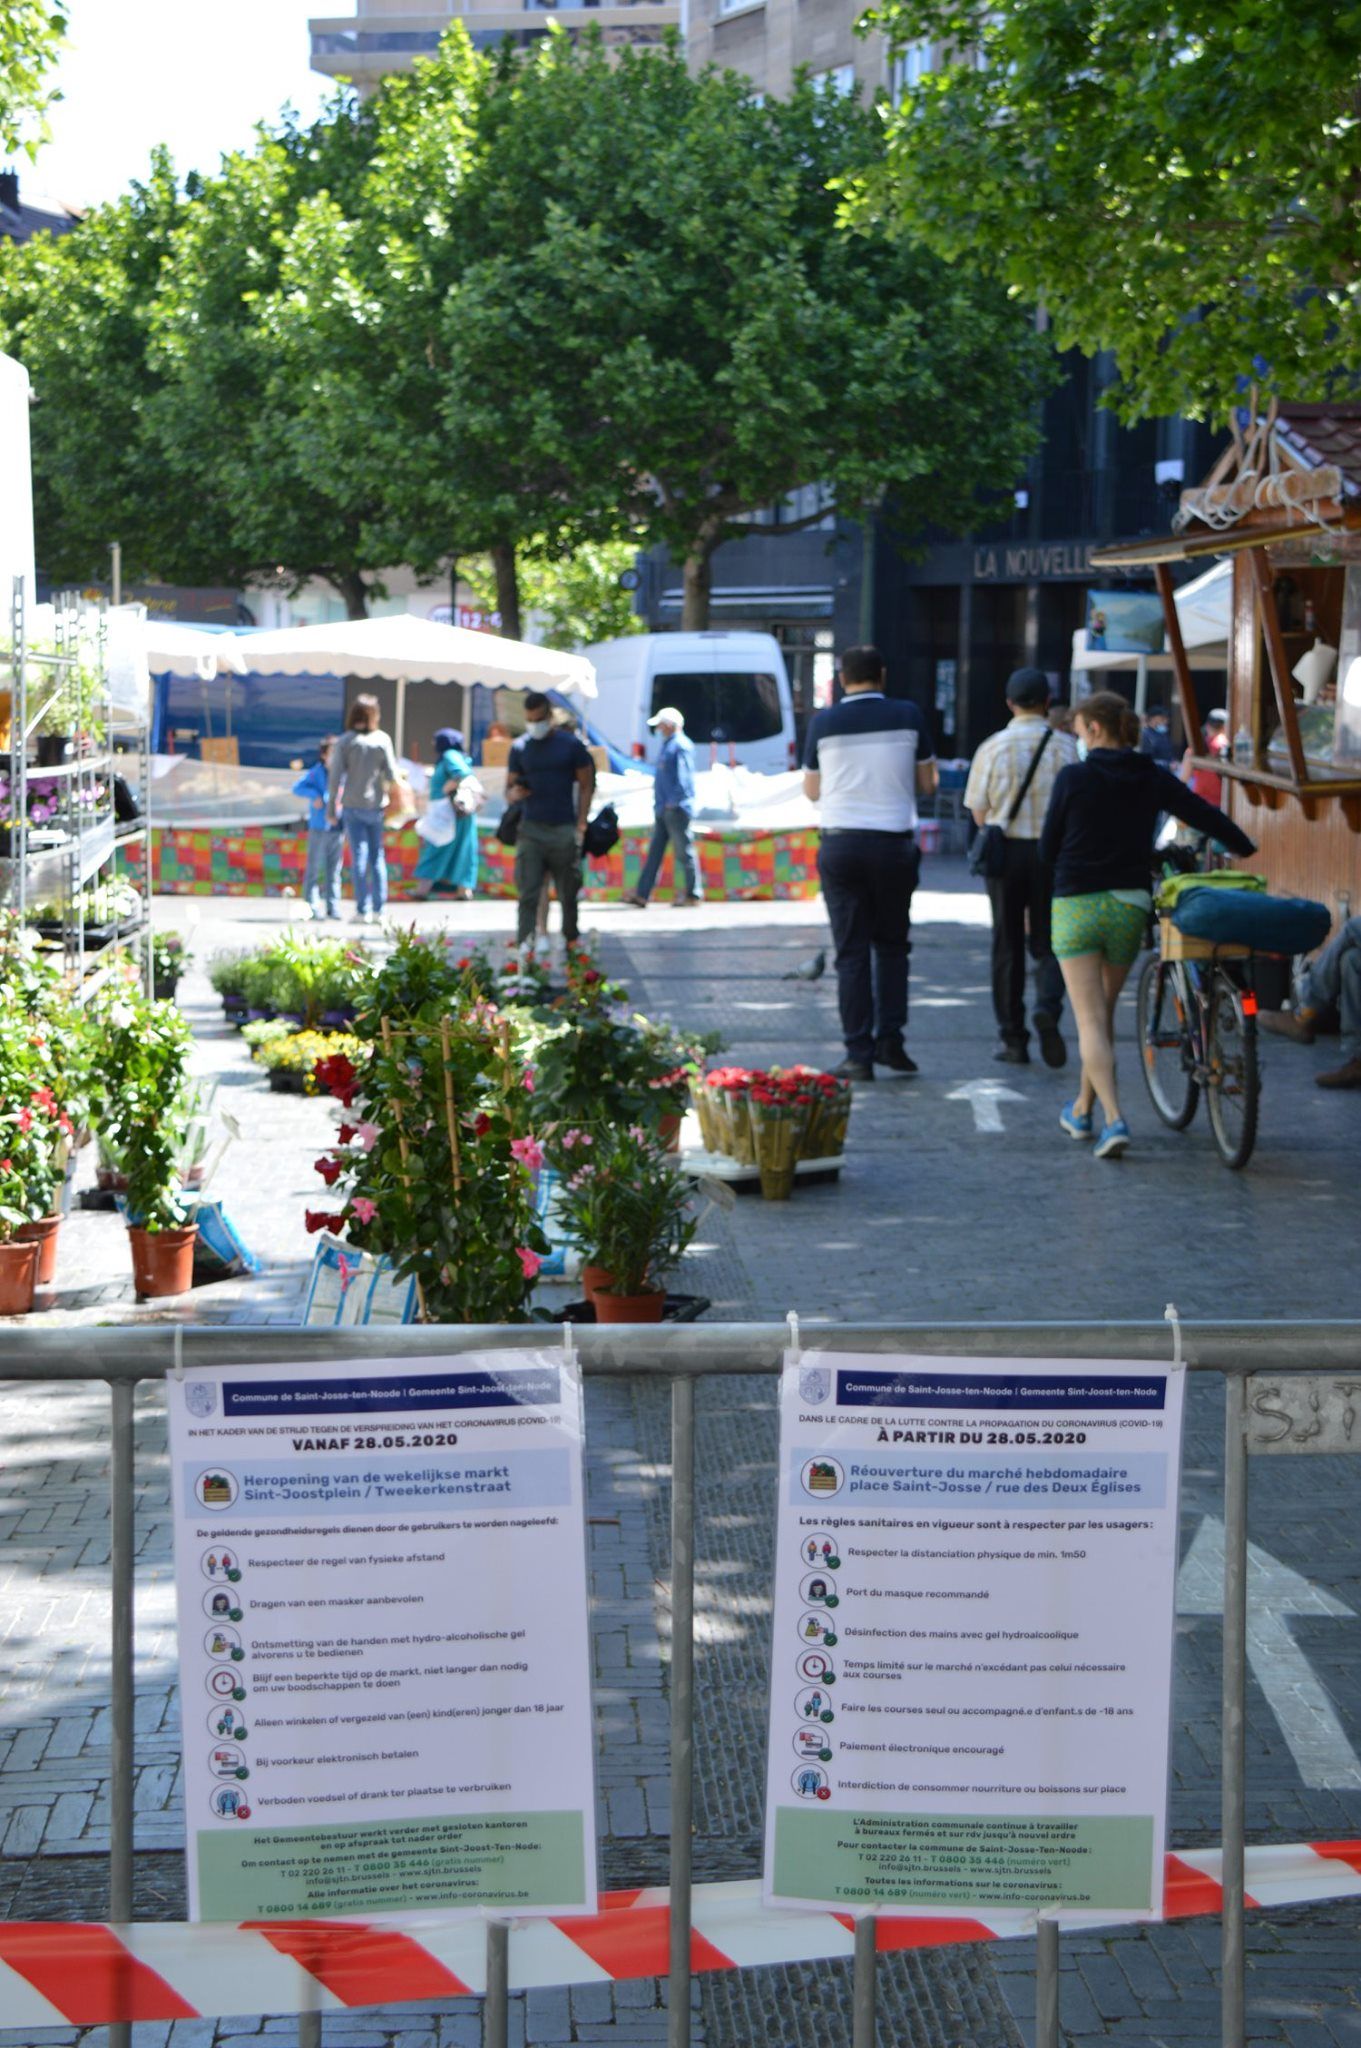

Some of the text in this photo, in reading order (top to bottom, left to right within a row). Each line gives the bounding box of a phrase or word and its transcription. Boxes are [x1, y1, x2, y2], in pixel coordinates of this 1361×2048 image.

[974, 549, 998, 578] LA
[1006, 545, 1096, 577] NOUVELLE
[231, 1392, 279, 1403] Commune
[279, 1392, 293, 1401] de
[293, 1388, 401, 1401] Saint-Josse-ten-Noode
[407, 1386, 456, 1396] Gemeente
[844, 1383, 893, 1392] Commune
[893, 1384, 906, 1393] de
[907, 1384, 1013, 1395] Saint-Josse-ten-Noode
[1019, 1387, 1066, 1396] Gemeente
[1066, 1386, 1158, 1396] Sint-Joost-ten-Node
[798, 1414, 1164, 1429] DANS LE CADRE DE LA LUTTE CONTRE LA PROPAGATION DU CORONAVIRUS (COVID-19)
[292, 1433, 457, 1451] VANAF 28.05.2020
[876, 1427, 1086, 1445] À PARTIR DU 28.05.2020
[243, 1466, 509, 1489] Heropening van de wekelijkse markt
[849, 1464, 1128, 1480] Réouverture du marché hebdomadaire
[244, 1483, 361, 1503] Sint-Joostplein
[374, 1480, 511, 1497] Tweekerkenstraat
[849, 1479, 890, 1492] place
[892, 1480, 982, 1493] Saint-Josse
[995, 1484, 1020, 1493] rue
[1022, 1483, 1049, 1493] des
[1051, 1481, 1088, 1493] Deux
[1090, 1479, 1141, 1495] Églises
[798, 1516, 1153, 1531] Les règles sanitaires en vigueur sont à respecter par les usagers:
[247, 1552, 446, 1568] Respecteer de regel van fysieke afstand
[847, 1547, 1087, 1560] Respecter la distanciation physique de min. 1m50
[845, 1587, 990, 1599] Port du masque recommandé
[249, 1594, 424, 1611] Dragen van een masker aanbevolen
[315, 1639, 334, 1647] van
[335, 1638, 349, 1647] de
[349, 1636, 389, 1646] handen
[389, 1635, 411, 1644] met
[509, 1629, 526, 1640] gel
[908, 1630, 927, 1638] des
[928, 1631, 958, 1639] mains
[959, 1631, 983, 1639] avec
[984, 1631, 1001, 1641] gel
[304, 1649, 316, 1658] te
[842, 1659, 876, 1670] Temps
[876, 1660, 905, 1670] limité
[923, 1662, 934, 1671] le
[934, 1663, 973, 1671] marché
[1028, 1664, 1047, 1672] pas
[1048, 1663, 1072, 1672] celui
[862, 1671, 902, 1680] courses
[840, 1702, 866, 1712] Faire
[866, 1704, 882, 1713] les
[883, 1706, 923, 1714] courses
[924, 1706, 946, 1714] seul
[946, 1707, 960, 1715] ou
[1083, 1707, 1097, 1716] de
[1099, 1706, 1115, 1715] -18
[838, 1741, 1005, 1756] Paiement électronique encouragé
[255, 1749, 419, 1768] Bij voorkeur elektronisch betalen
[837, 1780, 896, 1790] Interdiction
[896, 1782, 910, 1791] de
[911, 1784, 970, 1792] consommer
[970, 1784, 1022, 1793] nourriture
[1037, 1785, 1081, 1794] boissons
[1099, 1785, 1127, 1794] place
